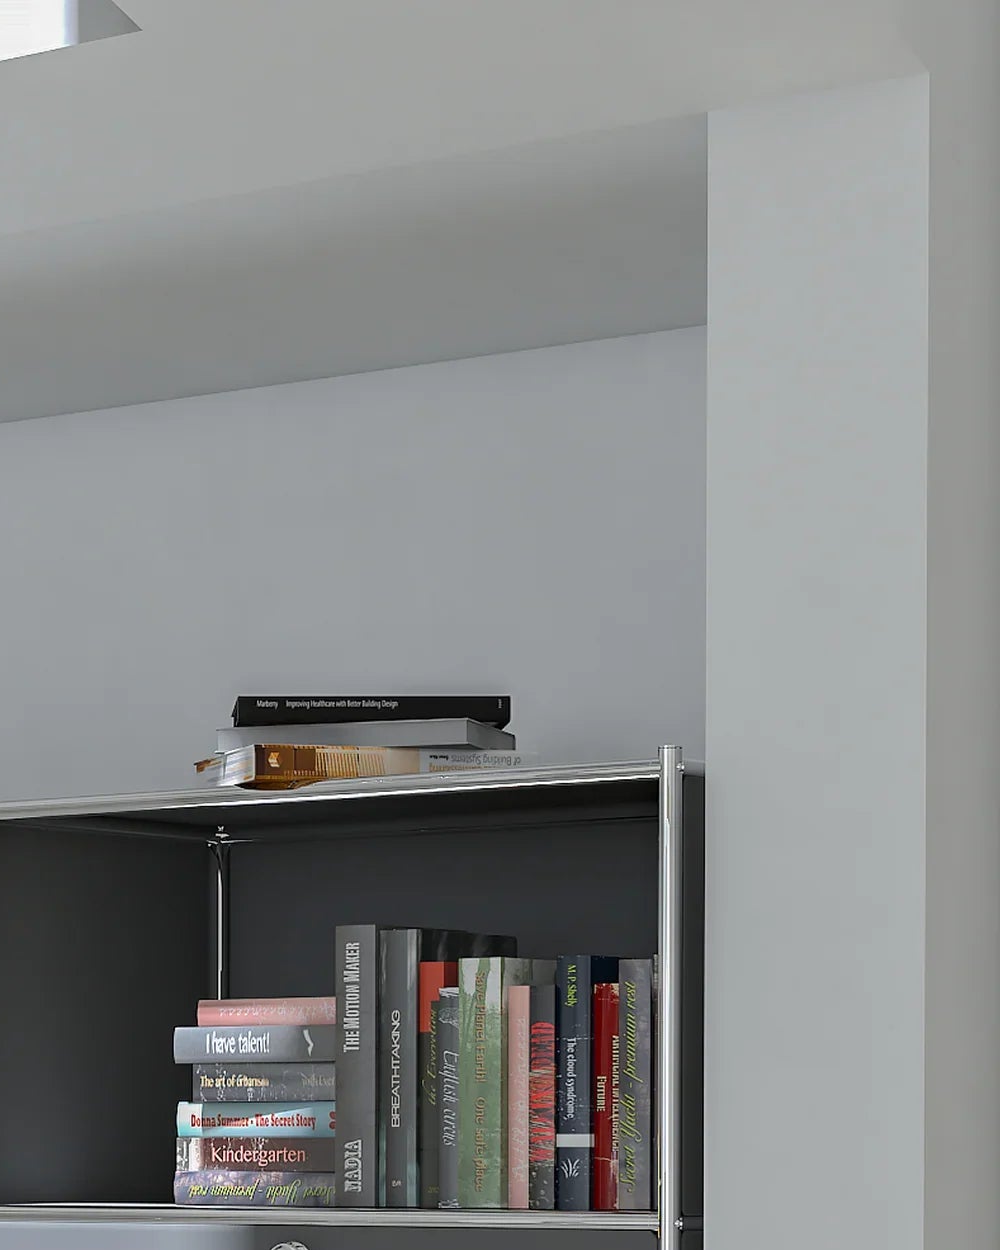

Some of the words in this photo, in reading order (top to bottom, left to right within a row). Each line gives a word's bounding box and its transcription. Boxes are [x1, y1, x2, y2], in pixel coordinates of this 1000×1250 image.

[474, 971, 488, 1001] Save
[622, 980, 636, 1010] rest
[474, 1003, 487, 1043] Planet
[212, 1031, 236, 1054] have
[238, 1030, 270, 1054] talent!
[566, 1037, 577, 1053] The
[622, 1014, 644, 1083] premium
[391, 1009, 401, 1128] BREATHTAKING
[439, 1050, 459, 1104] English
[566, 1054, 577, 1077] cloud
[200, 1075, 214, 1088] The
[215, 1074, 226, 1088] art
[226, 1074, 236, 1088] of
[190, 1114, 216, 1128] Donna
[217, 1114, 249, 1128] Summer
[254, 1113, 269, 1127] The
[271, 1113, 295, 1128] Secret
[296, 1114, 316, 1131] Story
[474, 1096, 486, 1123] One
[620, 1095, 642, 1142] Yacht
[211, 1146, 306, 1167] Kindergarten
[619, 1145, 636, 1193] Secret
